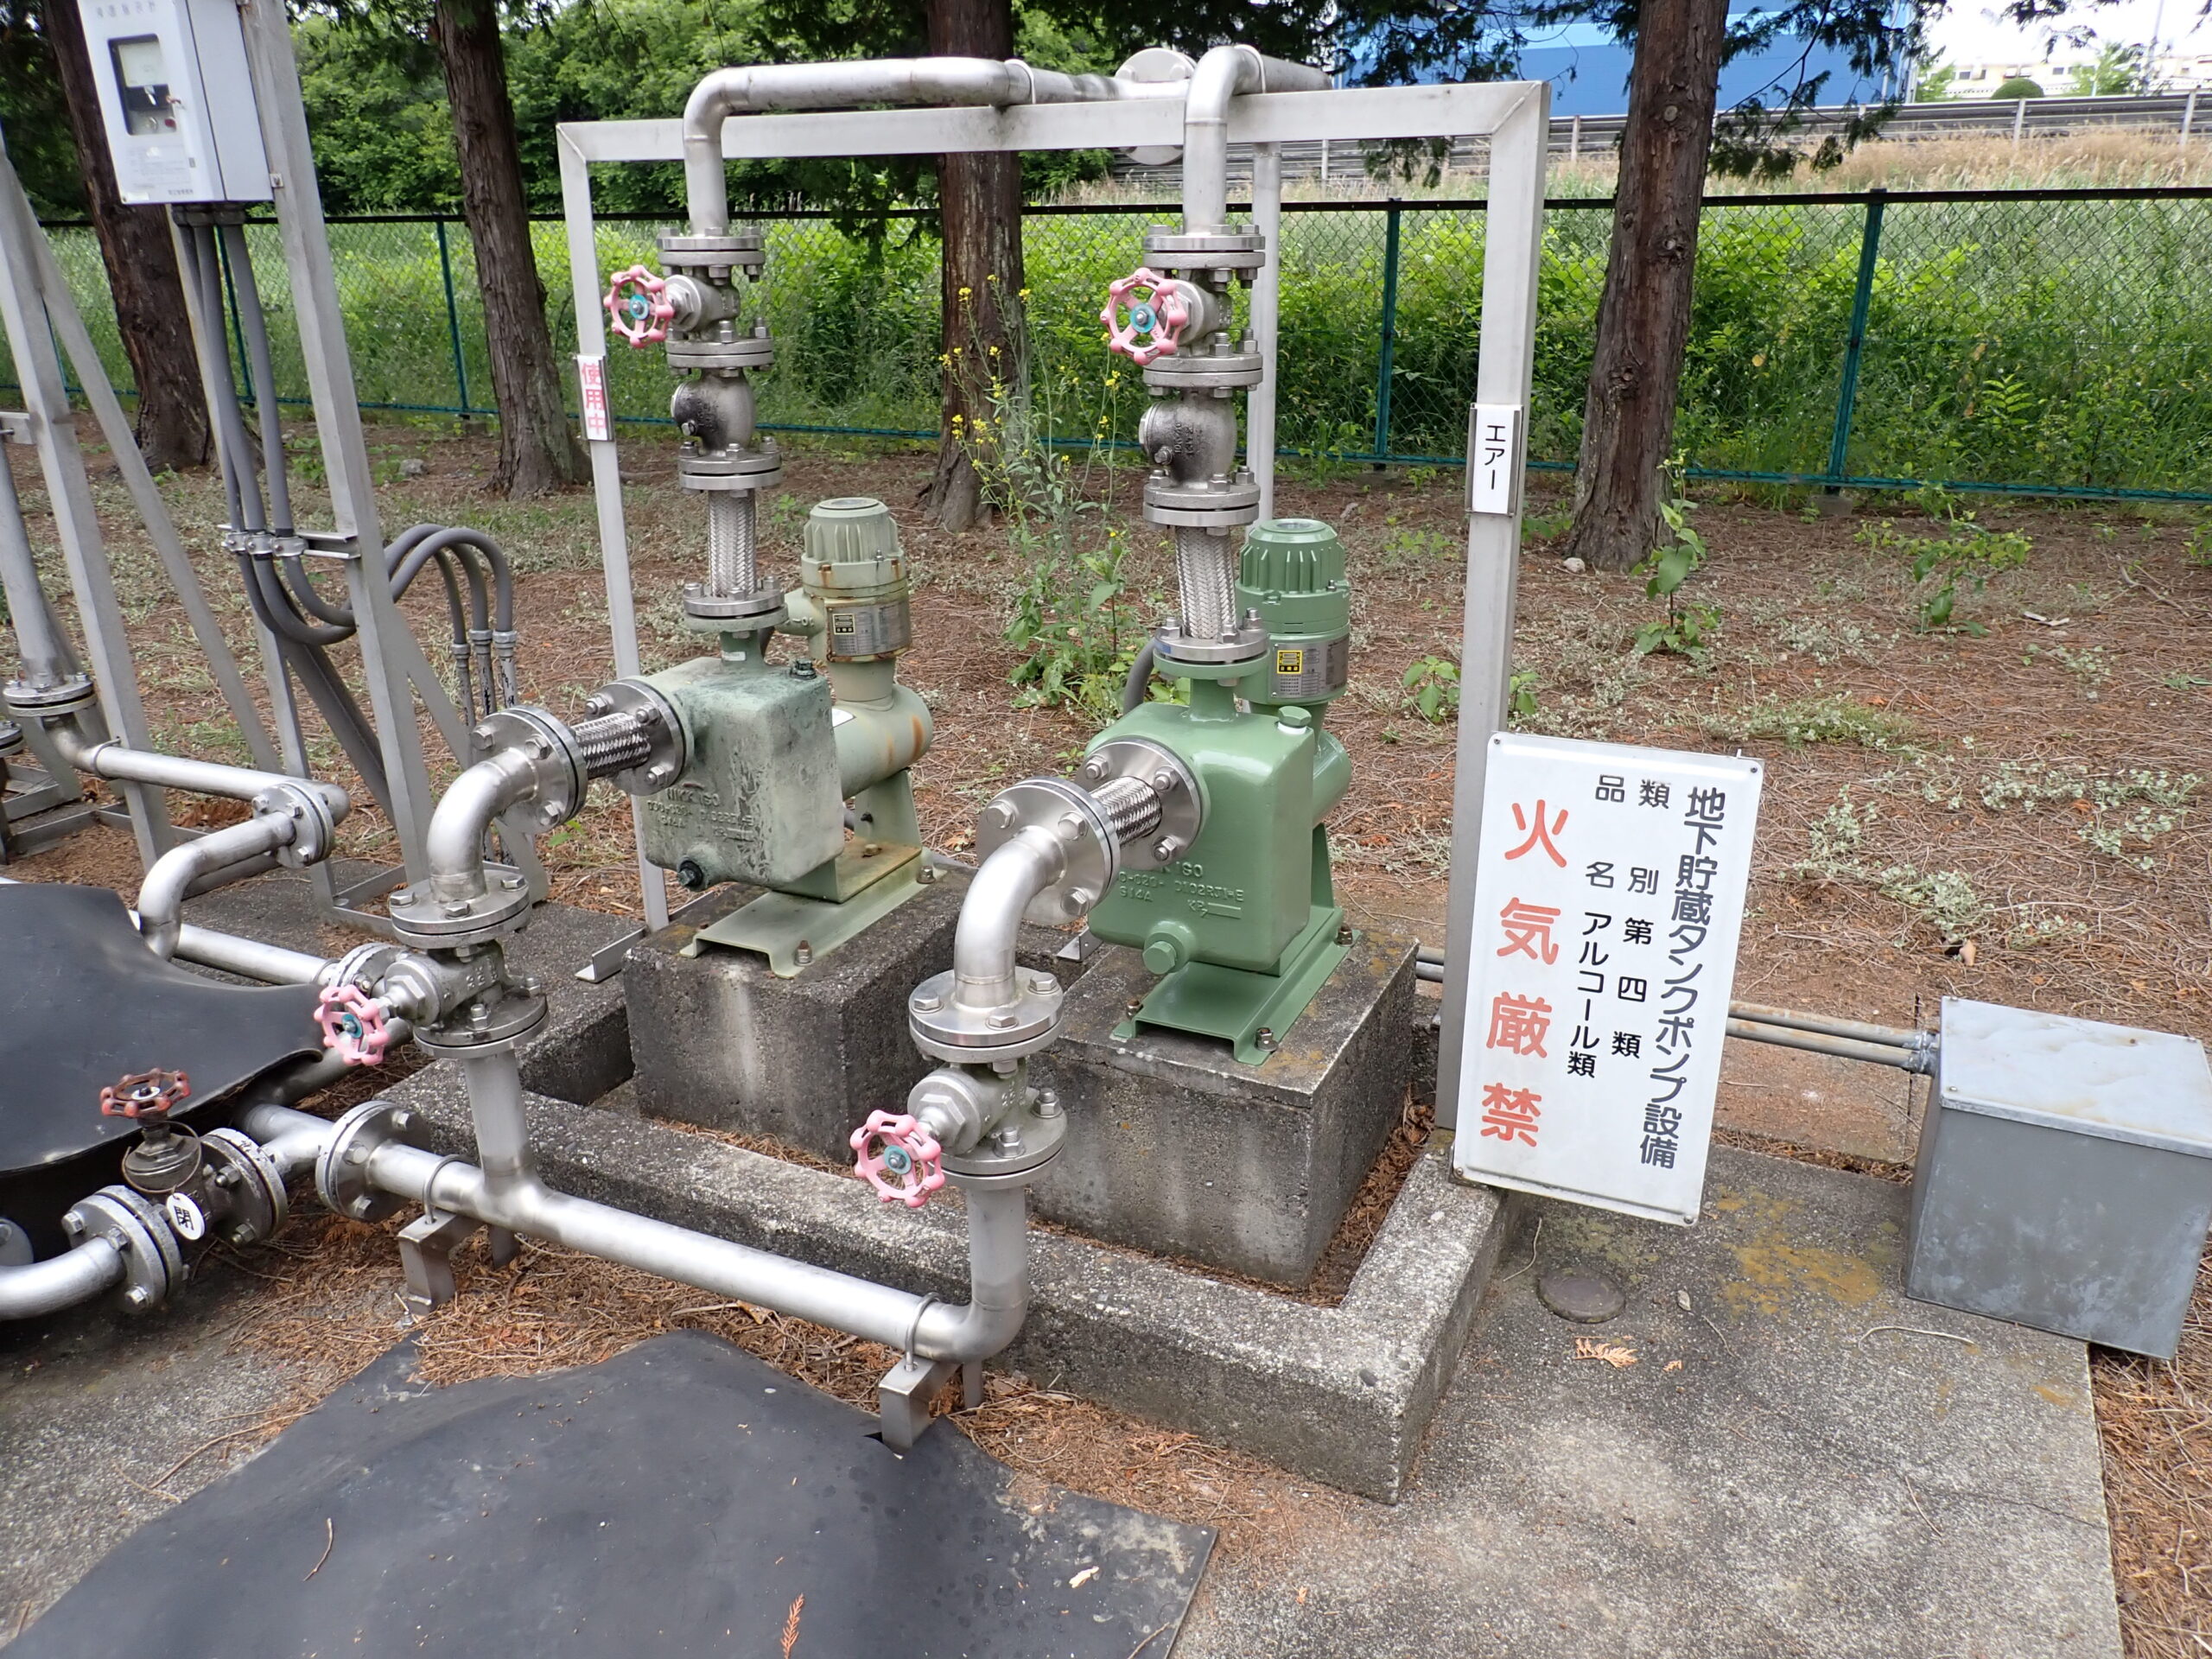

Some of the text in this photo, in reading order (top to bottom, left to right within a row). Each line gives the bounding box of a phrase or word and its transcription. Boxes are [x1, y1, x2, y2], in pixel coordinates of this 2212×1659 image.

[582, 362, 607, 435] 使用中
[1484, 425, 1506, 490] エアー
[1480, 799, 1568, 1147] 火気厳禁
[1567, 774, 1624, 1078] 品名 アルコール類
[1640, 786, 1725, 1169] 地下貯蔵タンクポンプ設備
